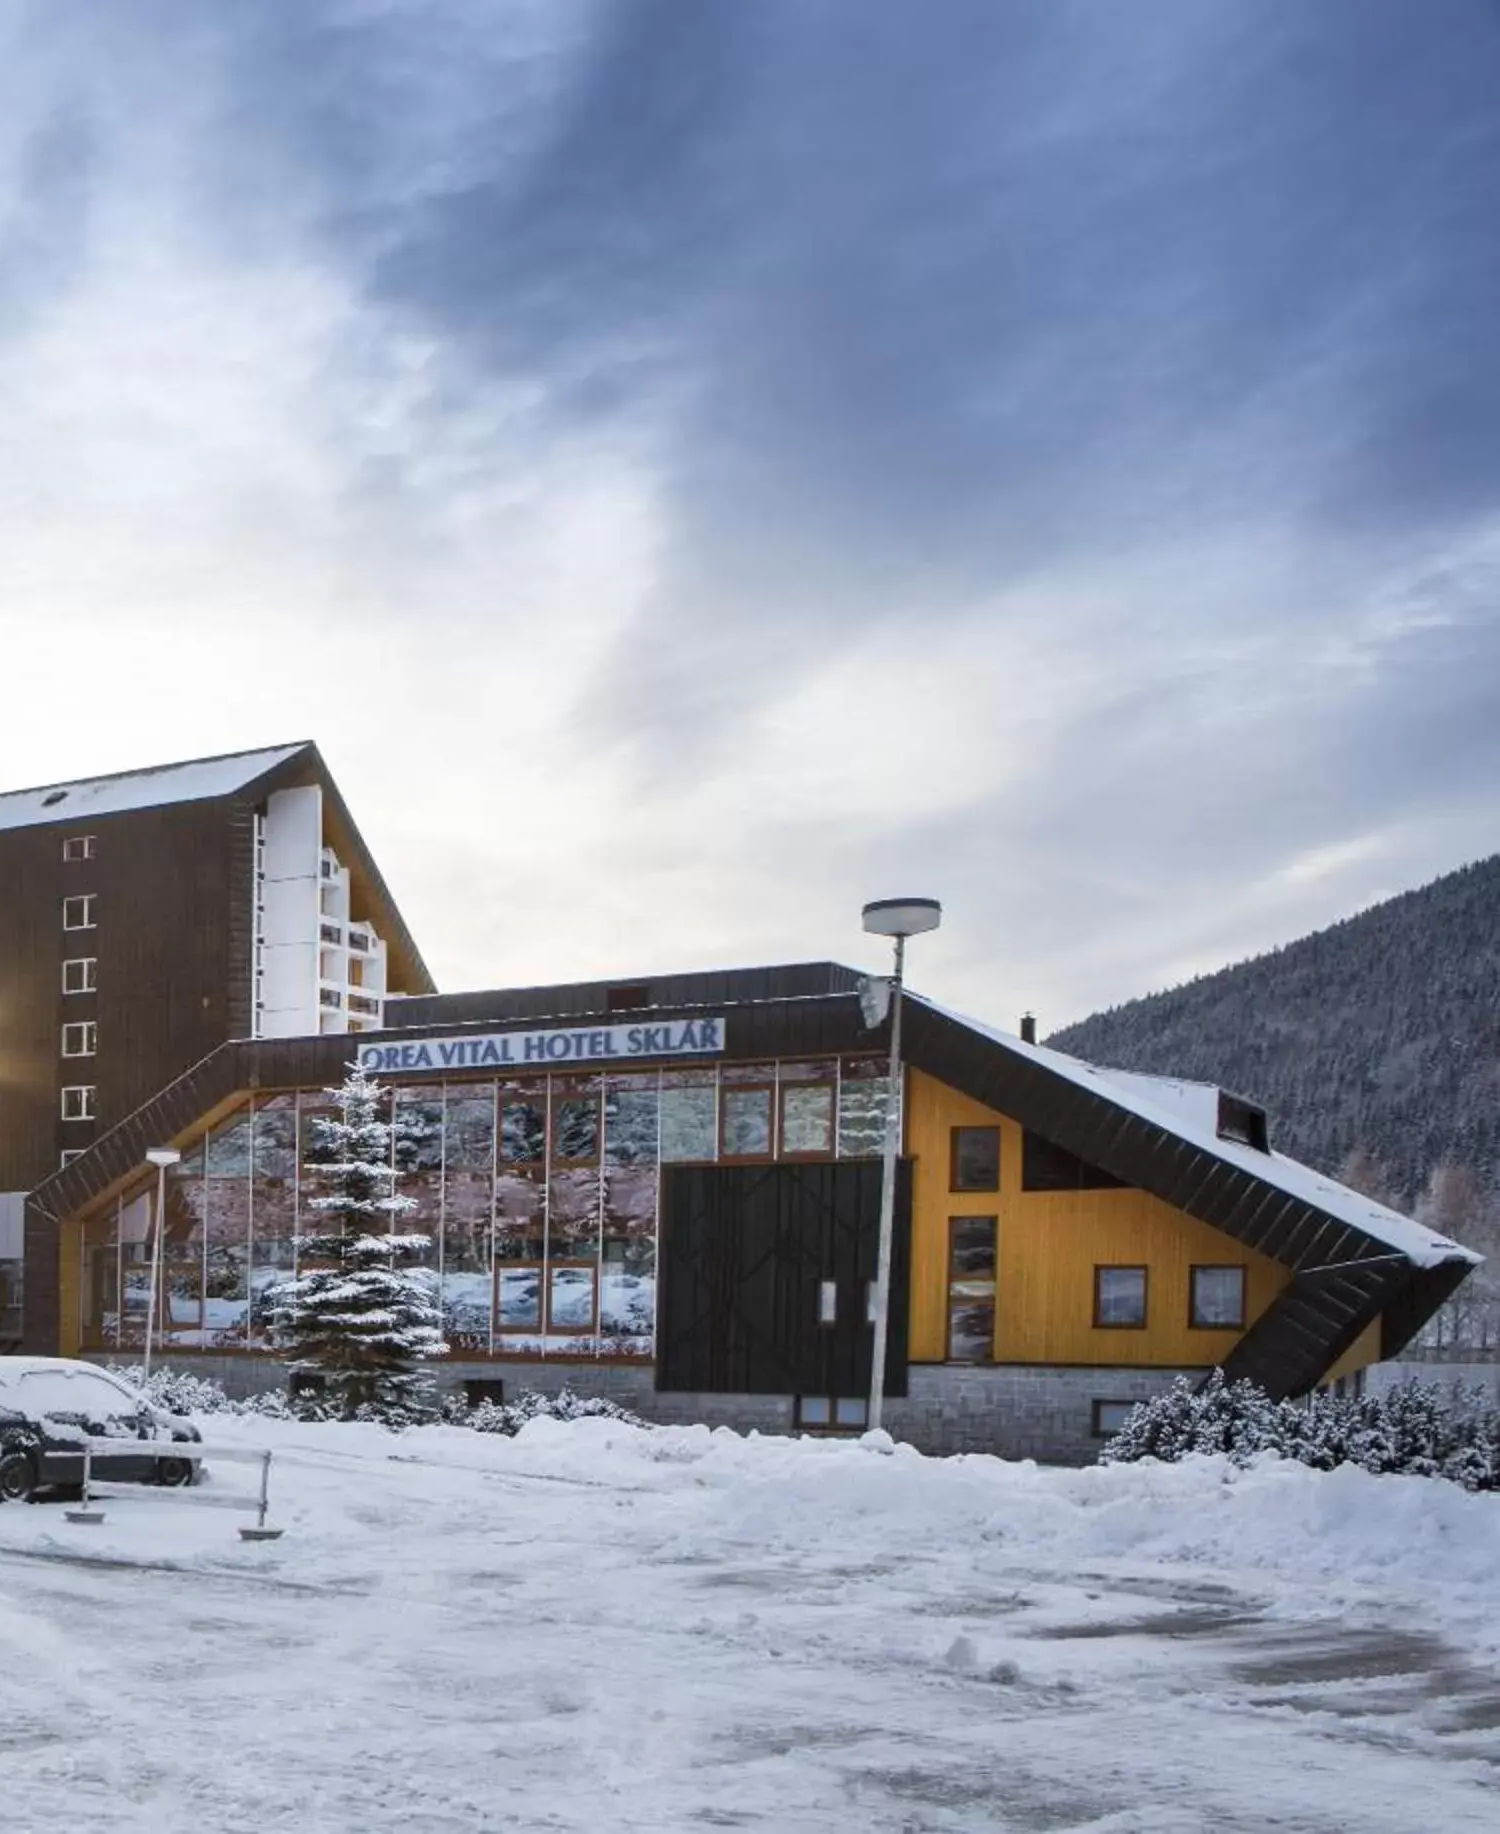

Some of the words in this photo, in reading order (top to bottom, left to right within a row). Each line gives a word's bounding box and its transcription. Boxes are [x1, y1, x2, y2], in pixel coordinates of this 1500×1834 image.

[362, 1043, 432, 1071] OREA
[438, 1037, 514, 1064] VITAL
[524, 1030, 618, 1060] HOTEL
[627, 1019, 718, 1054] SKLÁŘ
